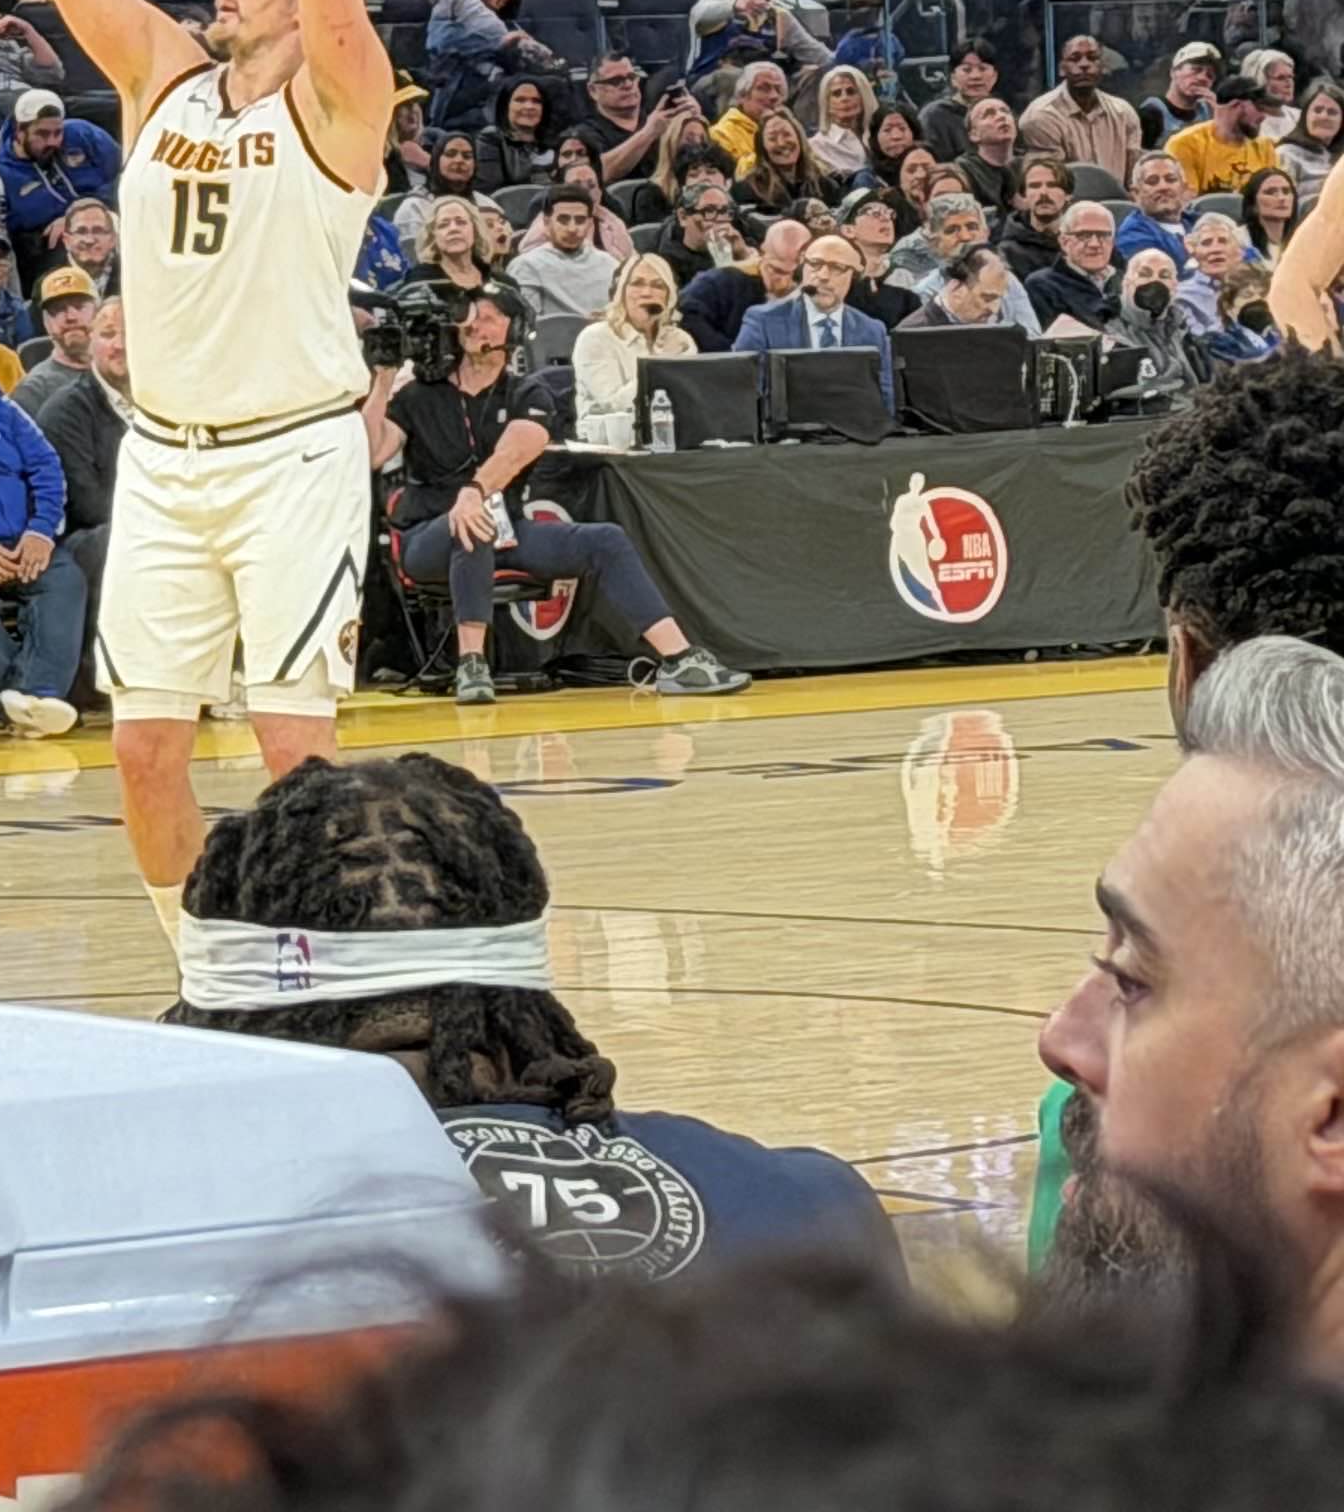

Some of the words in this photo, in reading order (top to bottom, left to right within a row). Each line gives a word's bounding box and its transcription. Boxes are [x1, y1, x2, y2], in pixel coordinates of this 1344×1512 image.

[169, 177, 231, 257] 15
[962, 532, 993, 559] NBA
[938, 560, 995, 583] ESPN
[593, 1144, 658, 1172] 1950
[500, 1170, 621, 1228] 75
[659, 1179, 694, 1250] LLOYD
